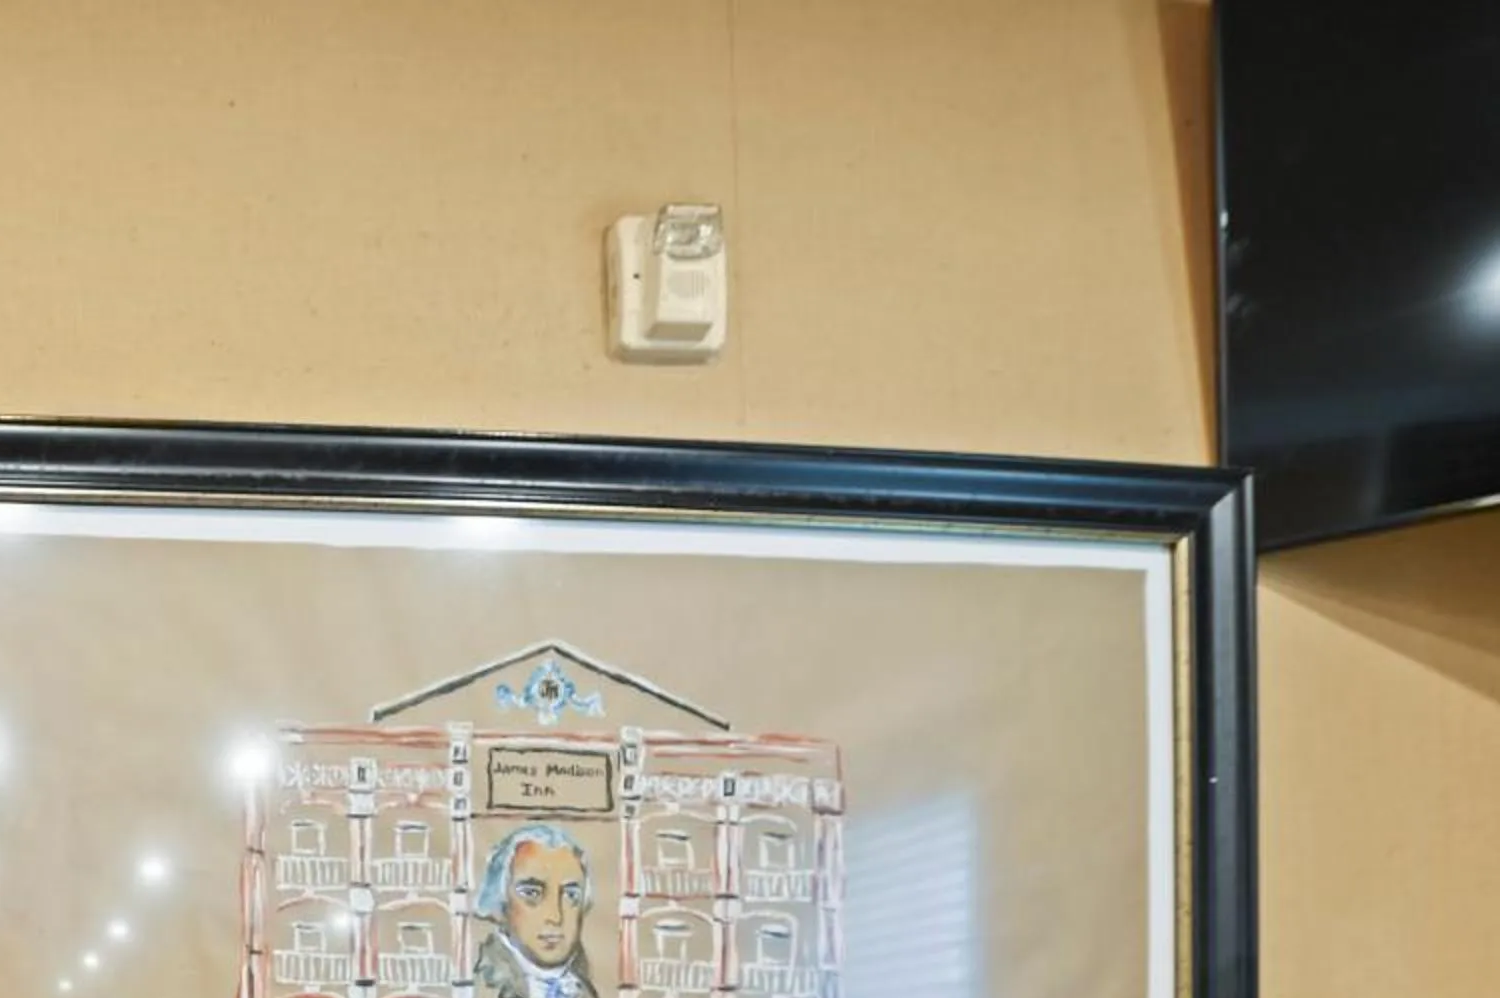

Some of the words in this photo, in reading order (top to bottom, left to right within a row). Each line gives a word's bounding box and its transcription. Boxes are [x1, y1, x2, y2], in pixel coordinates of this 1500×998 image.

[493, 762, 537, 776] James
[545, 763, 604, 777] Madison
[520, 783, 556, 797] Inn
